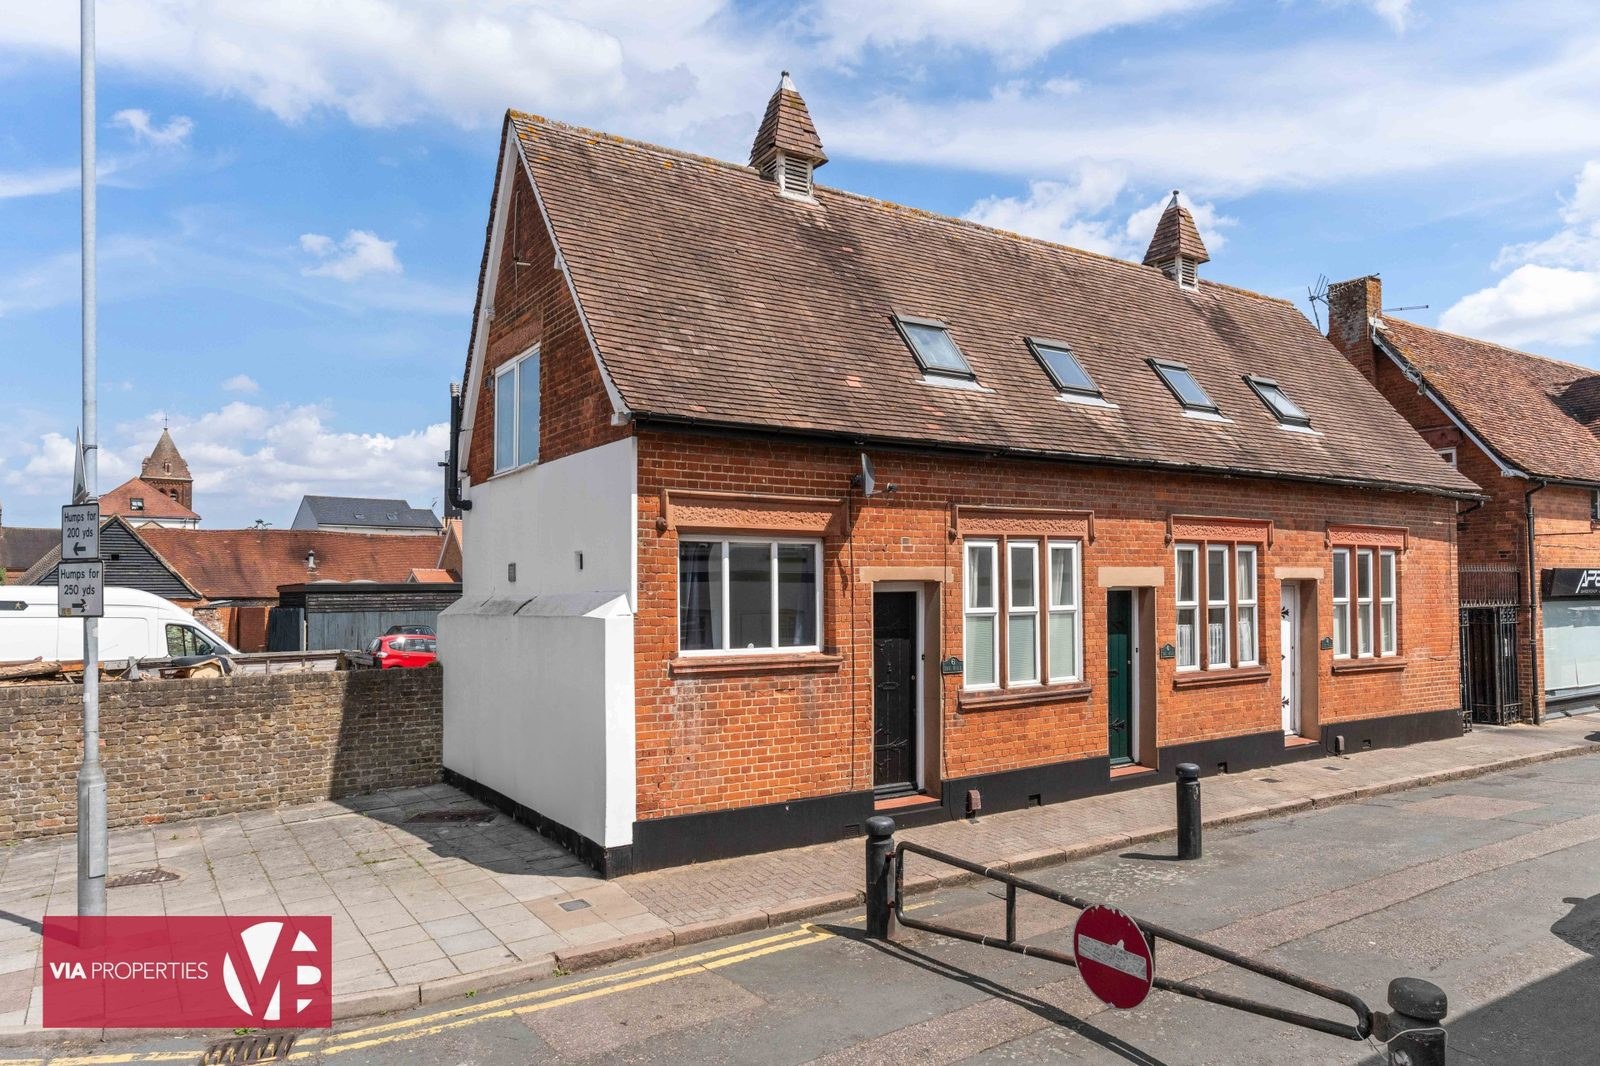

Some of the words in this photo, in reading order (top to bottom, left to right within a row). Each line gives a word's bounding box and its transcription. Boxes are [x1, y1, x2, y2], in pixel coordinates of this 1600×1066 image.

[64, 512, 84, 523] Humps
[86, 511, 96, 521] for
[67, 527, 80, 538] 200
[82, 528, 94, 540] yds
[60, 569, 86, 581] Humps
[88, 568, 99, 579] for
[63, 585, 79, 595] 250
[82, 585, 95, 597] yds
[951, 658, 956, 666] 6
